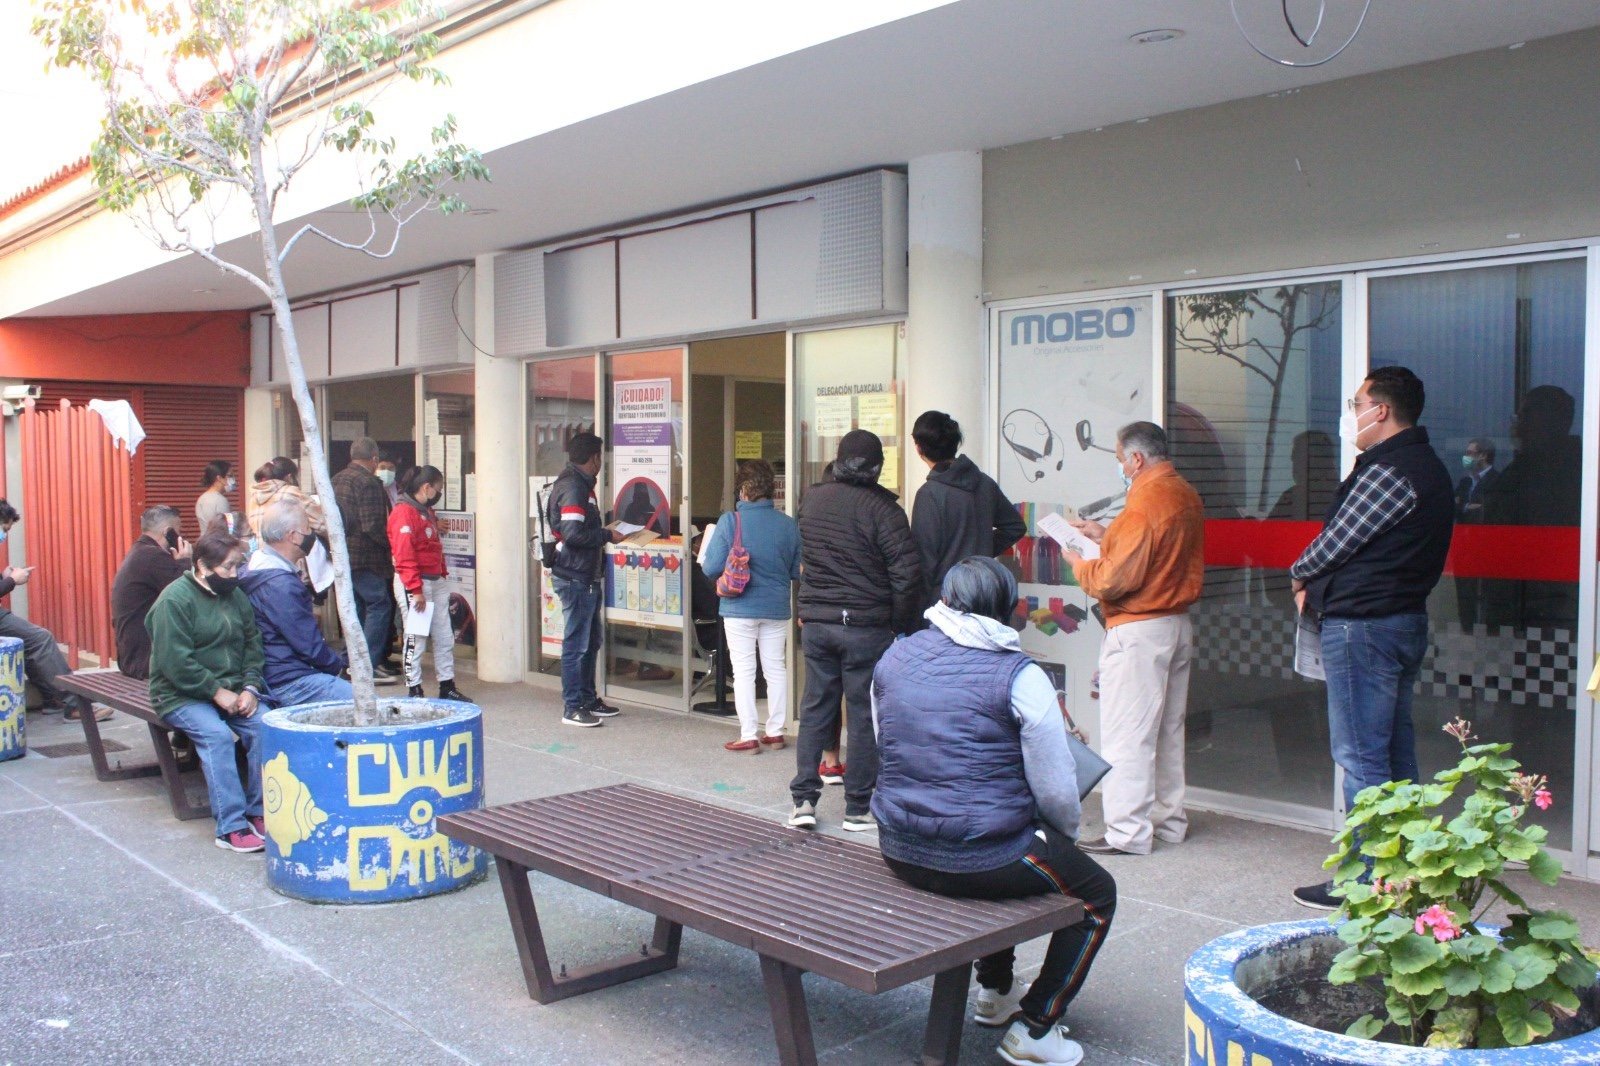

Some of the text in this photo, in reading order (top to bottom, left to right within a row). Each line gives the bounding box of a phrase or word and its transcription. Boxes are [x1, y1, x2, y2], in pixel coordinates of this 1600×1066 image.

[1011, 306, 1135, 346] MOBO
[621, 387, 664, 404] ¡CUIDADO!
[817, 382, 883, 397] DELEGACIÓN TLAXCALA
